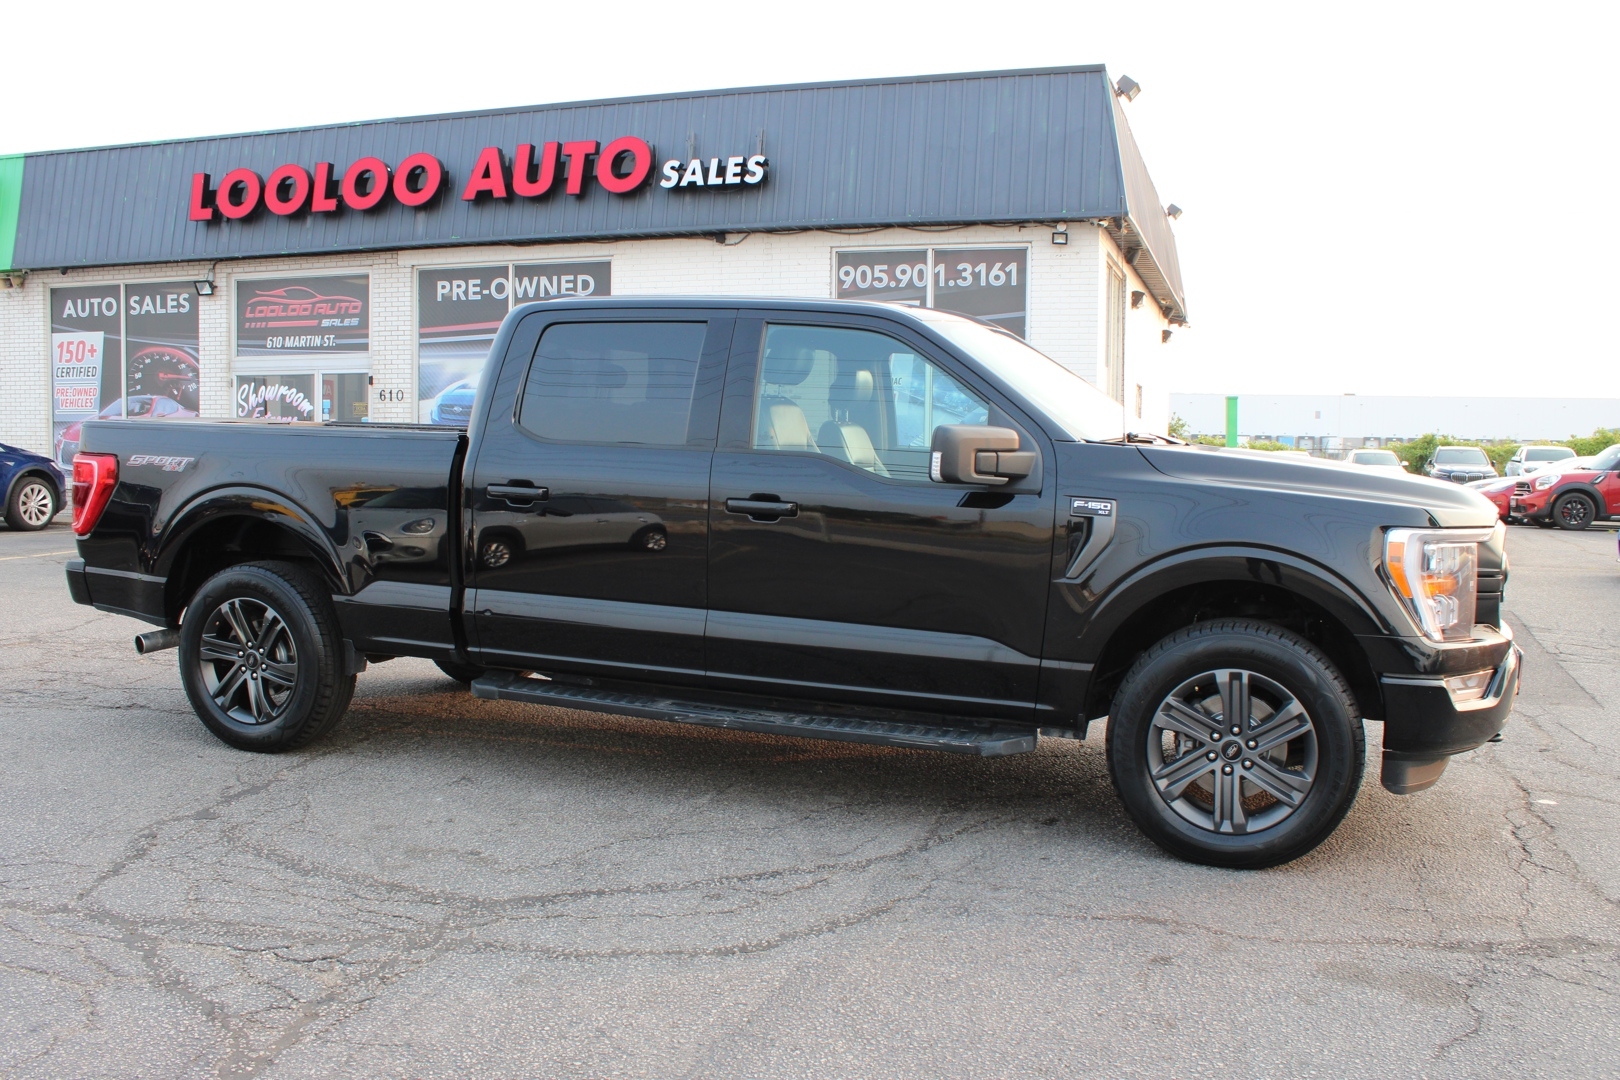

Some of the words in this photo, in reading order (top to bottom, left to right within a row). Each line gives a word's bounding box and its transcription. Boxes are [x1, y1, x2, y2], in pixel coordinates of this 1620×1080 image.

[190, 152, 442, 221] LOOLOO
[461, 136, 652, 201] AUTO
[660, 155, 767, 189] SALES
[838, 262, 1018, 288] 905.901.3161
[436, 274, 595, 302] PRE-OWNED
[62, 297, 117, 318] AUTO
[129, 293, 190, 315] SALES
[245, 304, 312, 318] LOOLOO
[313, 302, 362, 315] AUTO
[321, 318, 360, 327] SALES
[266, 336, 283, 348] 610
[285, 335, 321, 348] MARTIN
[323, 334, 336, 347] ST.
[56, 340, 98, 364] 150+
[55, 366, 97, 378] CERTIFIED
[56, 387, 97, 398] PRE-OWNED
[237, 381, 314, 417] Showroom
[379, 389, 404, 402] 610
[60, 397, 94, 408] VEHICLES
[126, 454, 195, 467] SPORT
[1073, 500, 1111, 510] F-150
